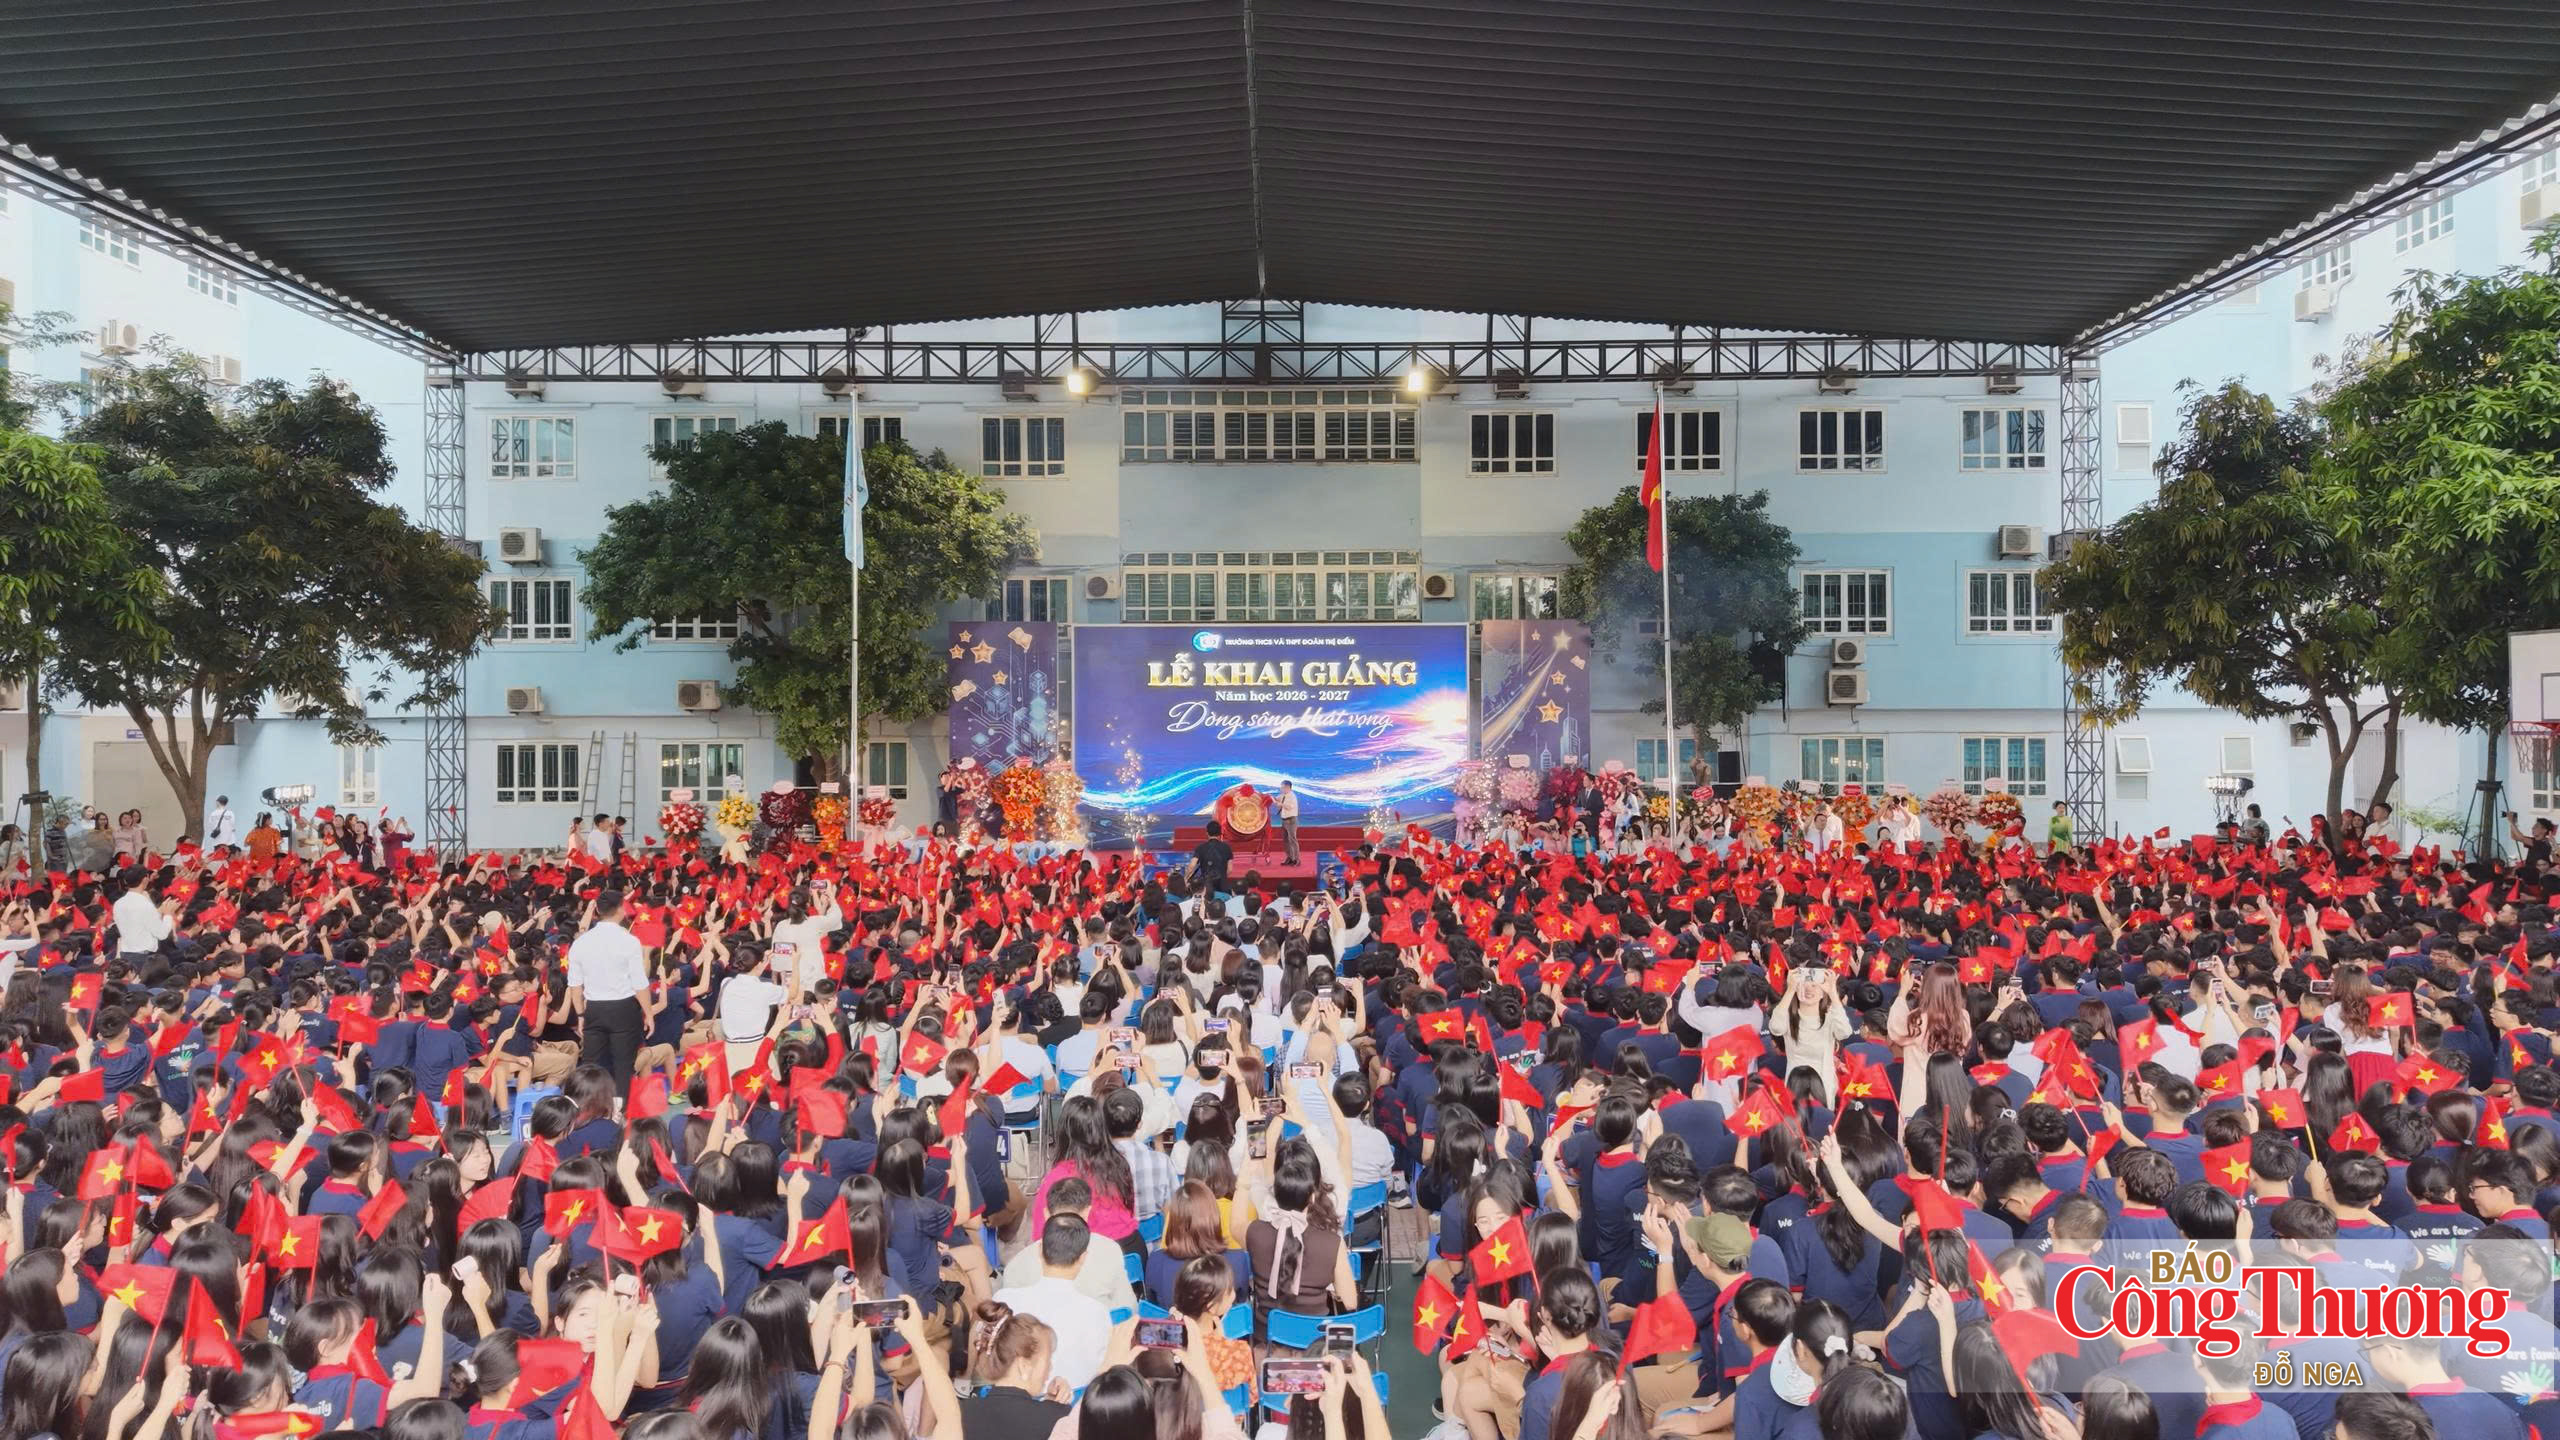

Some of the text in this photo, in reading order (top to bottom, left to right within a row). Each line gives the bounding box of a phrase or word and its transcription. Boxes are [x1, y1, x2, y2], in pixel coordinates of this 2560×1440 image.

[1147, 653, 1417, 687] LỄ KHAI GIẢNG
[1215, 691, 1248, 701] Năm
[1250, 690, 1273, 704] học
[1275, 690, 1307, 702] 2026
[1319, 690, 1350, 702] 2027
[1167, 701, 1393, 740] Dòng sông khát vọng
[1777, 1218, 1793, 1229] We
[2410, 1228, 2429, 1239] We
[2037, 1238, 2053, 1253] We
